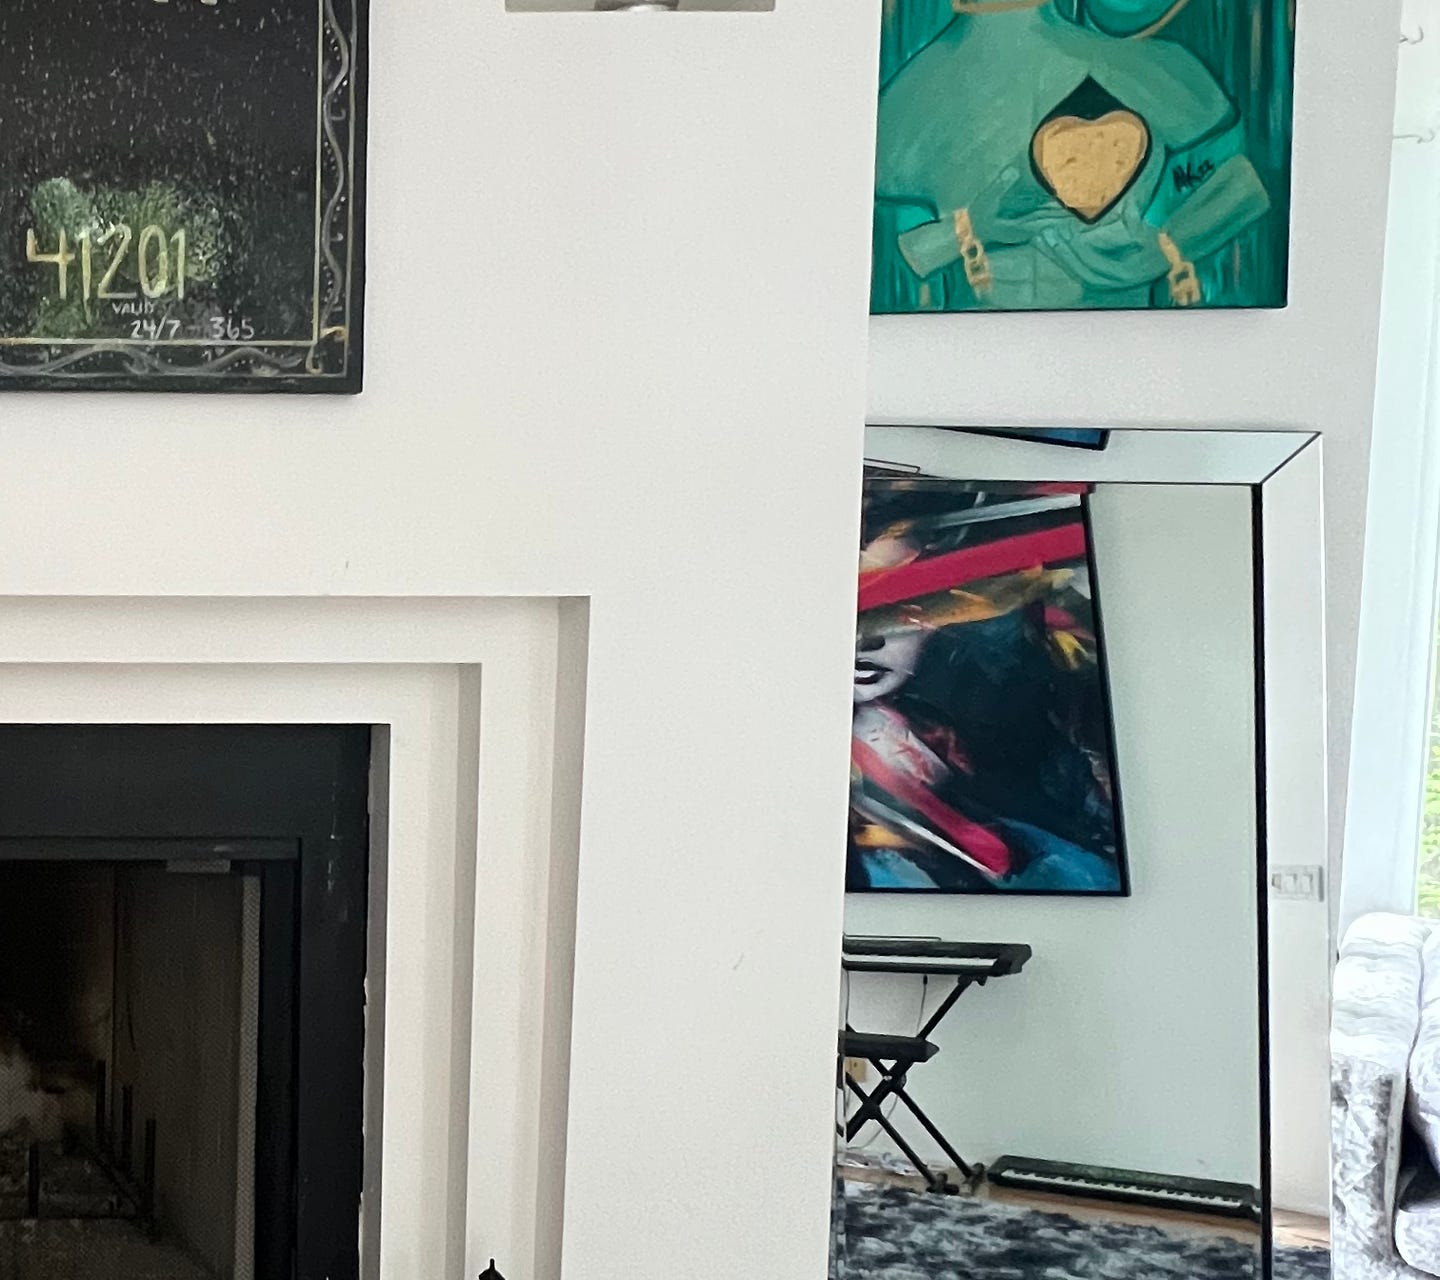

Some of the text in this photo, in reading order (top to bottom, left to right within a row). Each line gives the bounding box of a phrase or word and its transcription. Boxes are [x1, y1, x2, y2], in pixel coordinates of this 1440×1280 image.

[26, 222, 186, 301] 41201
[130, 306, 181, 341] 24/7
[209, 316, 255, 340] 365
